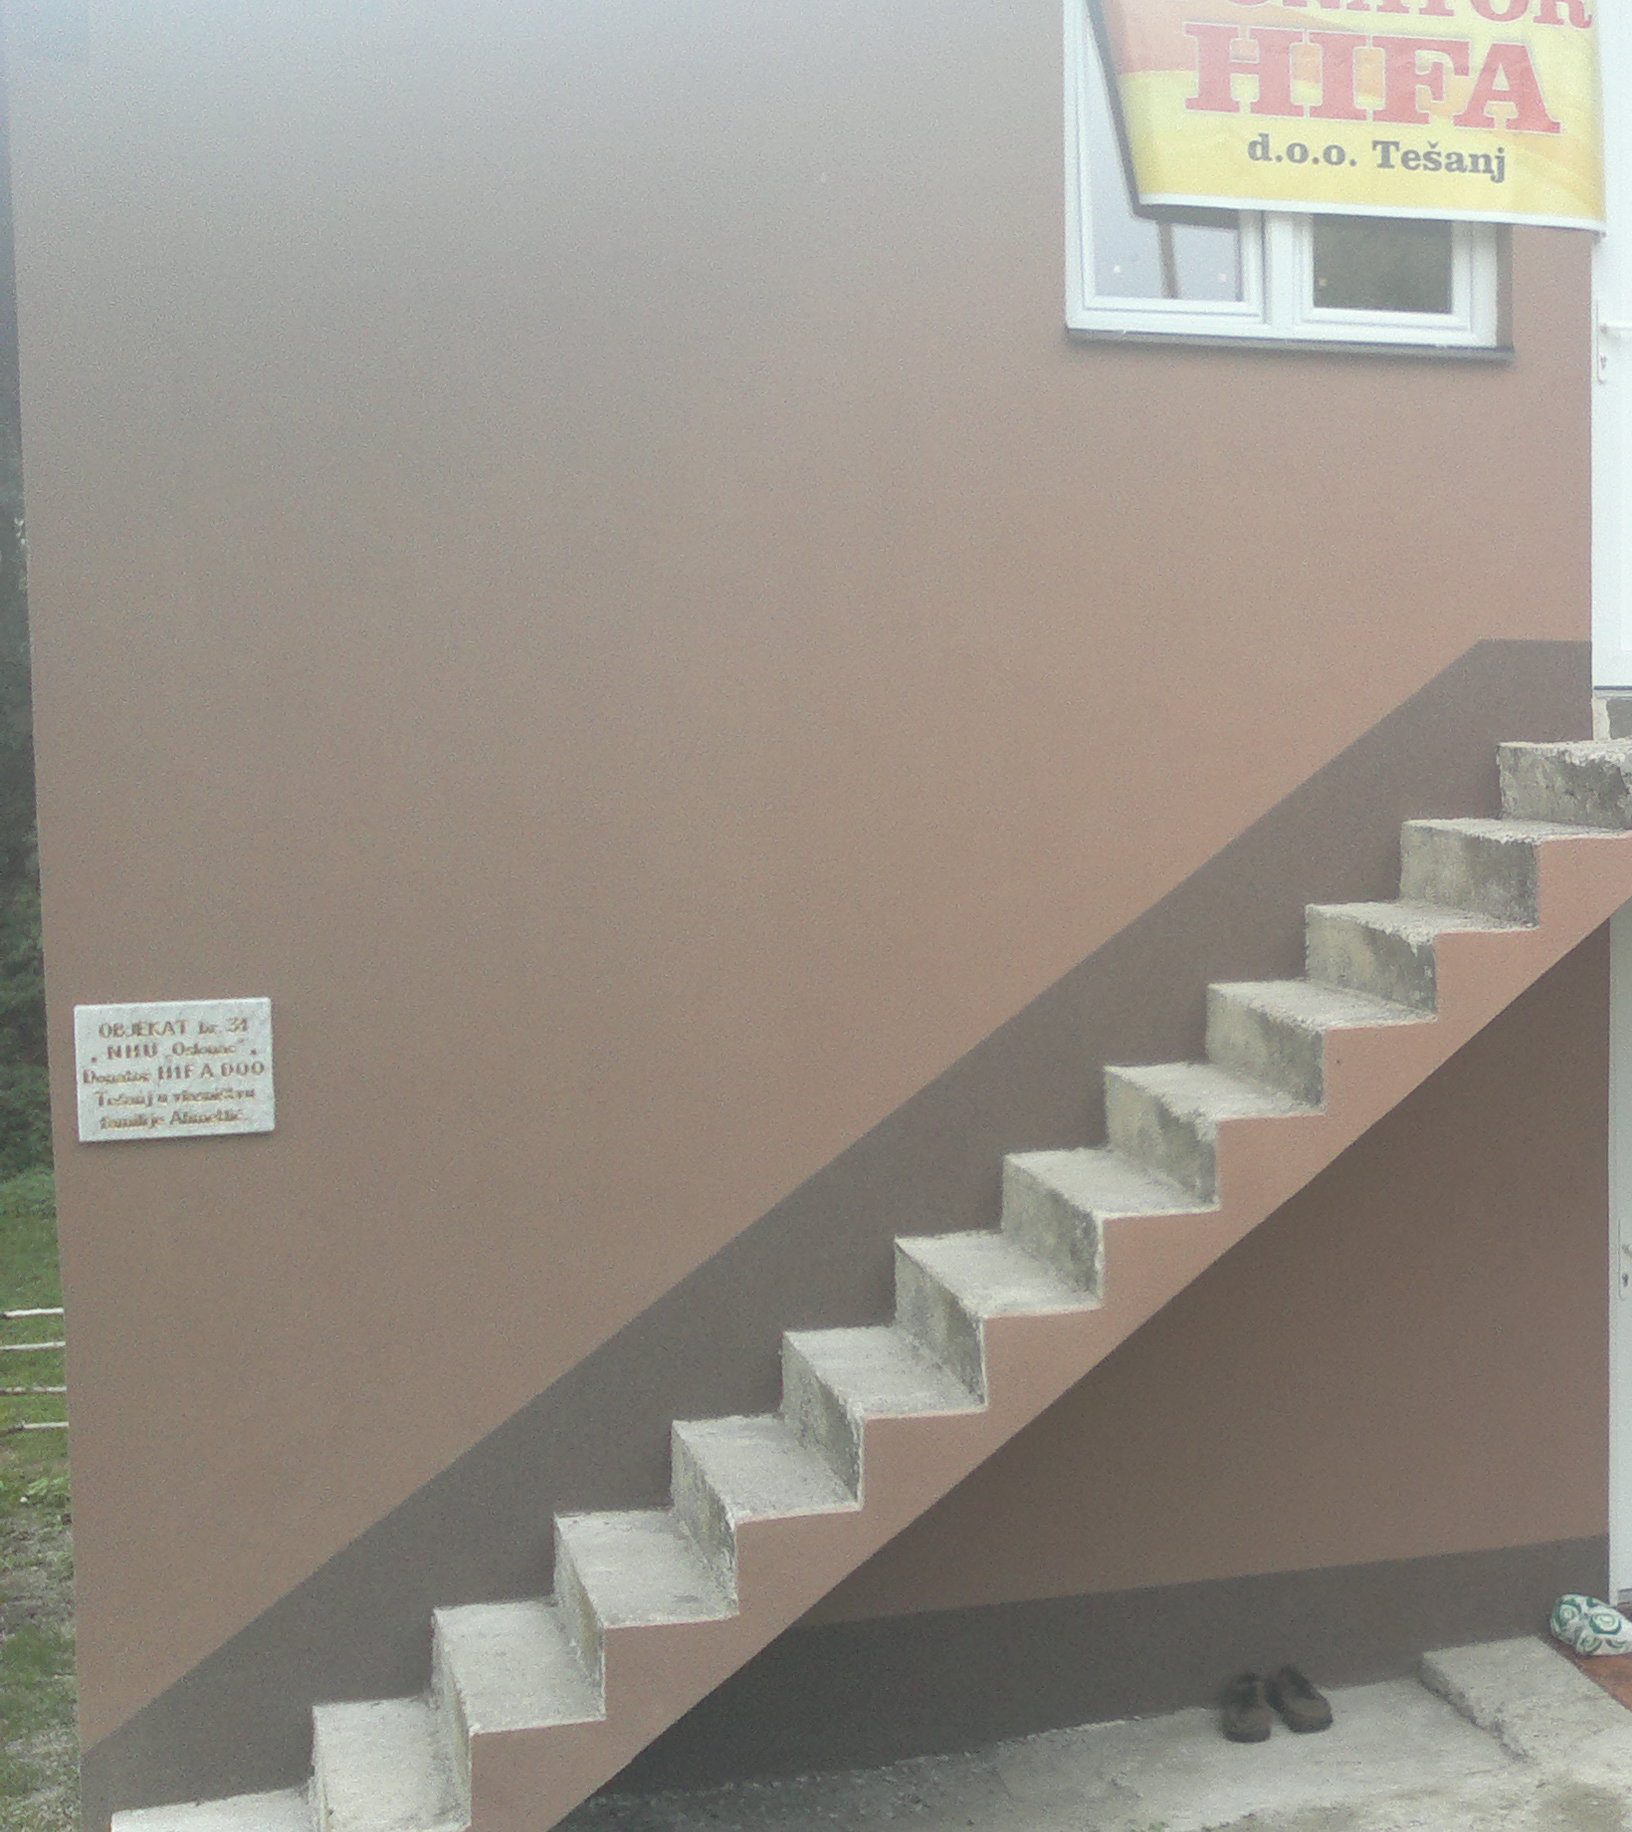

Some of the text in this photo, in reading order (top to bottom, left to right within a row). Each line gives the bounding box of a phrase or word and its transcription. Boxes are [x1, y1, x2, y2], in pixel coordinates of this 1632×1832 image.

[1184, 23, 1561, 133] HIFA
[1247, 133, 1506, 183] d.o.o. Tešanj
[99, 1020, 187, 1038] OBJEKAT
[107, 1043, 158, 1060] NHU
[221, 1061, 265, 1077] DOO
